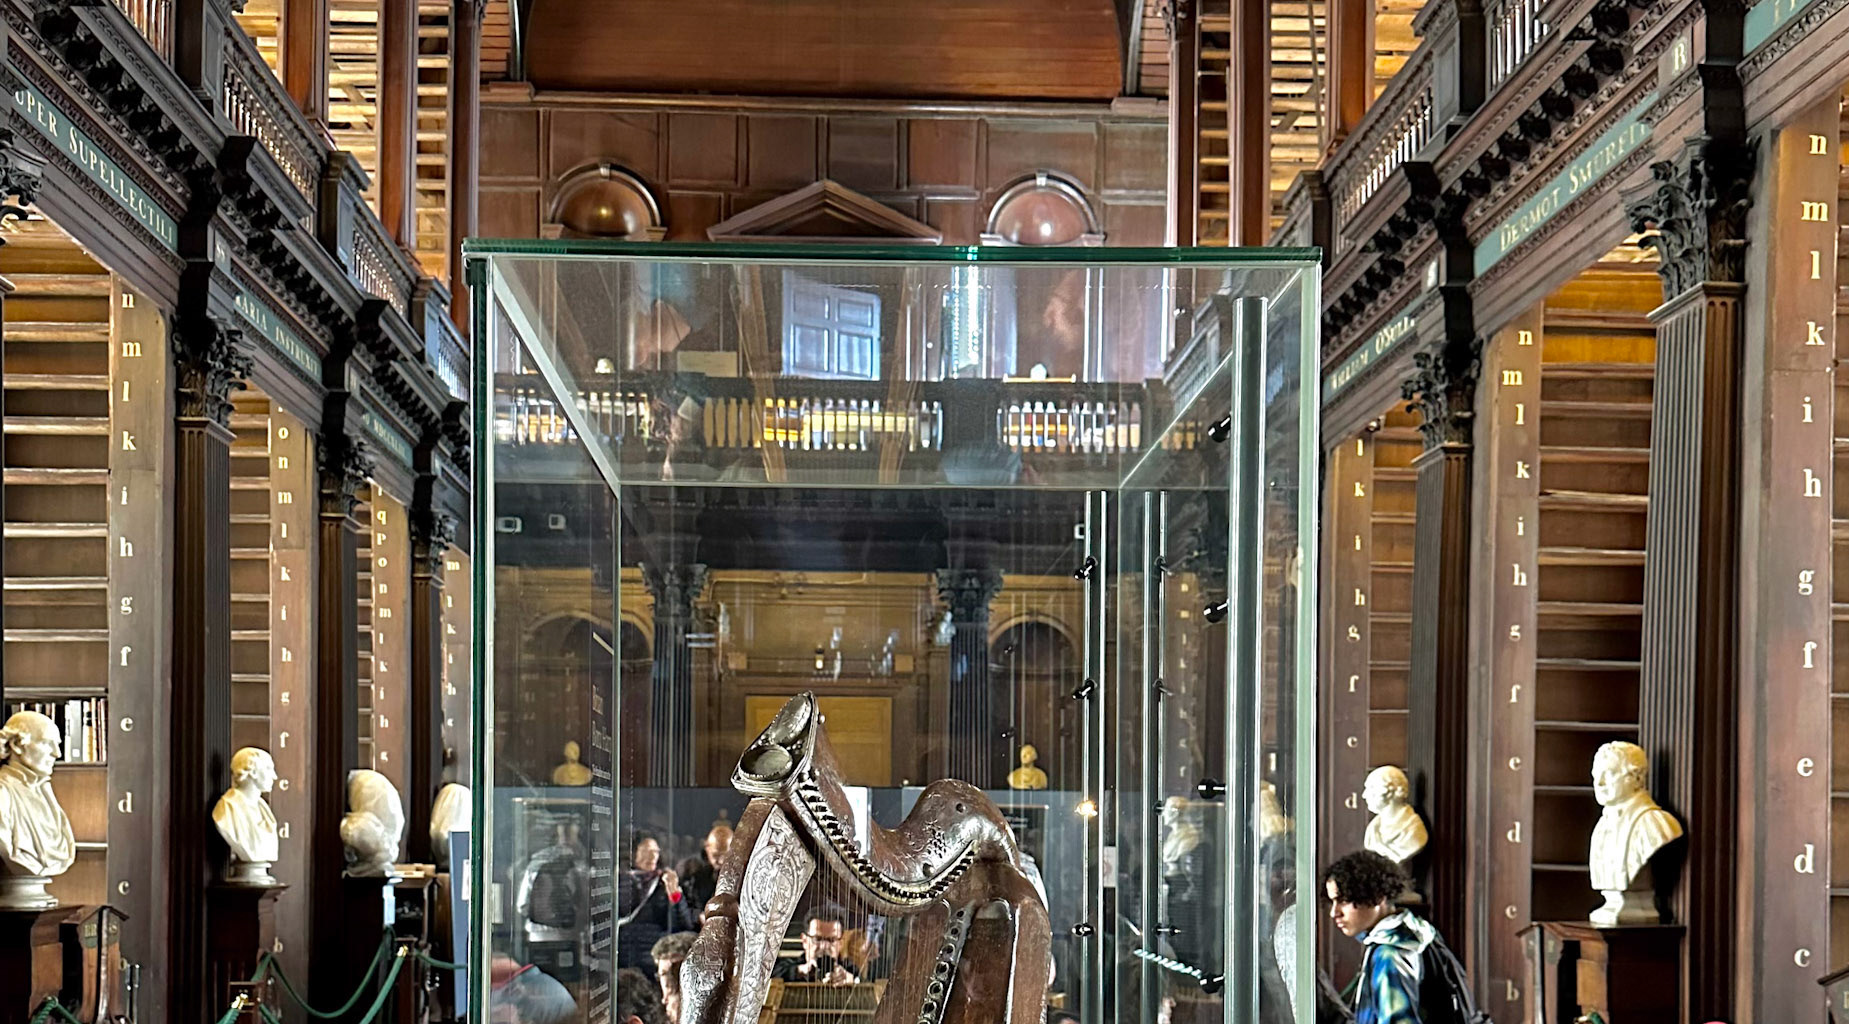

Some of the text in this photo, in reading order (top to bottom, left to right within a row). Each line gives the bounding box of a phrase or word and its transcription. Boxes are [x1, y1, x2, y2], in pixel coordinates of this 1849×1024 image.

[1808, 134, 1827, 155] n
[1500, 186, 1561, 252] DERMOT
[1800, 201, 1828, 222] m
[1810, 250, 1821, 280] l
[121, 293, 135, 308] n
[1518, 330, 1533, 346] n
[1805, 321, 1826, 346] k
[122, 341, 142, 358] m
[1502, 370, 1523, 386] m
[122, 380, 130, 402] l
[1515, 403, 1524, 425] l
[1802, 396, 1813, 423] i
[122, 430, 137, 451] k
[1516, 461, 1530, 479] k
[1803, 468, 1822, 498] h
[120, 486, 128, 506] i
[1517, 516, 1524, 536] i
[119, 536, 133, 557] h
[1513, 563, 1527, 587] h
[1799, 571, 1814, 595] g
[120, 596, 133, 615] g
[120, 645, 132, 667] f
[1802, 641, 1818, 669] f
[1510, 684, 1521, 703] f
[120, 717, 133, 732] e
[1509, 757, 1521, 770] e
[1796, 757, 1814, 777] e
[117, 791, 132, 813] d
[1506, 821, 1521, 843] d
[1793, 843, 1815, 874] d
[118, 881, 129, 895] c
[1505, 905, 1517, 919] c
[1794, 948, 1811, 968] c
[1506, 979, 1520, 1001] b
